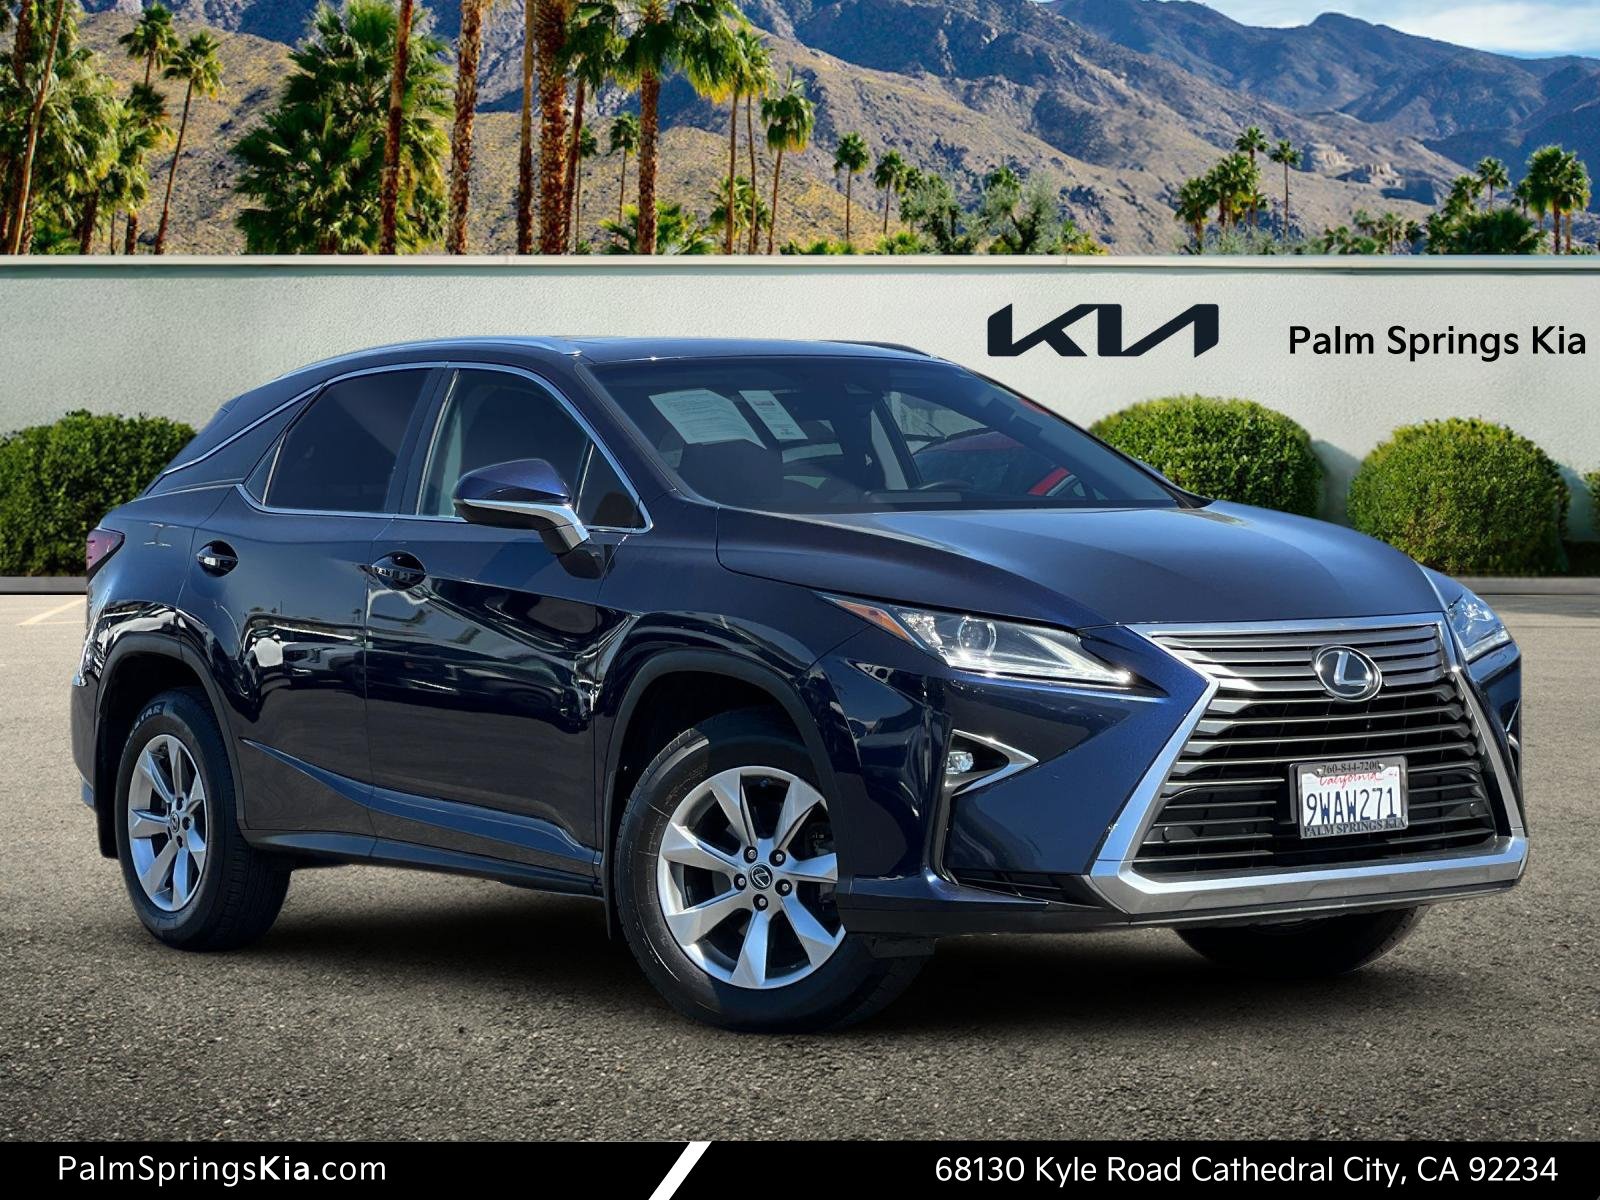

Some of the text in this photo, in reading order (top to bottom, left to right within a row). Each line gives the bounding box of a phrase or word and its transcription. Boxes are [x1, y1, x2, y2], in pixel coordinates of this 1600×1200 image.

[1289, 325, 1586, 363] Palm Springs Kia
[1321, 760, 1382, 774] 760-844-7200
[1306, 787, 1398, 826] 9WAW271
[1304, 817, 1405, 837] PALM SPRINGS KIA
